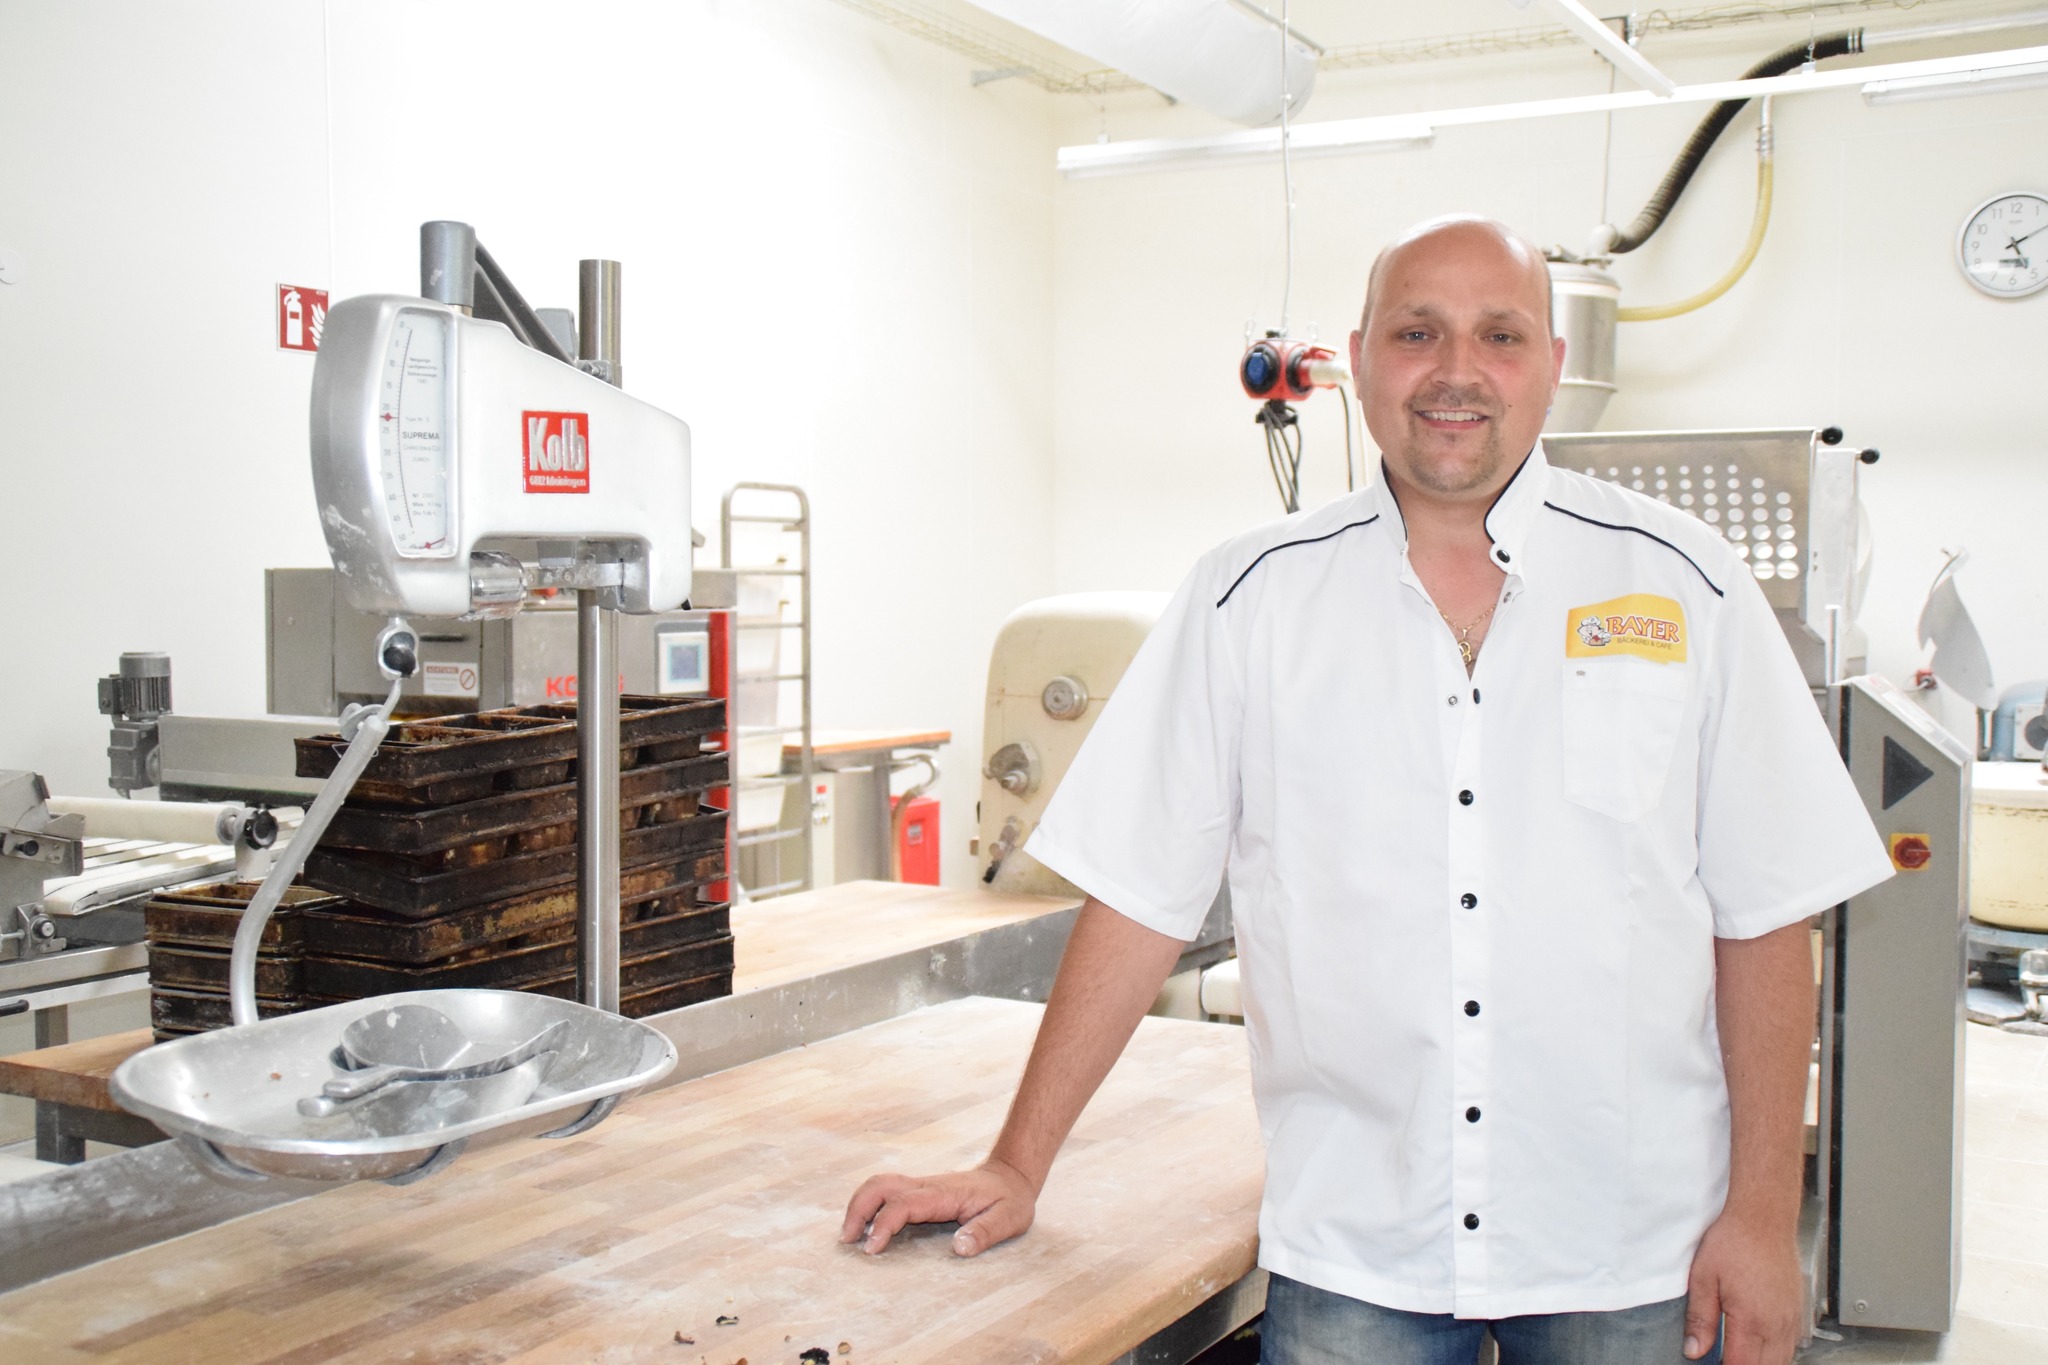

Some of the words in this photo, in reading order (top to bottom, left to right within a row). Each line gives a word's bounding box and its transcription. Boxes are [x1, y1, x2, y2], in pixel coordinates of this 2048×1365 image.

[1992, 208, 2003, 219] 11
[2010, 202, 2023, 214] 12
[2035, 205, 2039, 216] 1
[1977, 223, 1988, 235] 10
[1971, 240, 1980, 252] 9
[2030, 267, 2038, 280] 5
[2008, 274, 2017, 286] 6
[382, 403, 390, 411] 20
[382, 426, 390, 434] 25
[402, 431, 440, 440] SUPREMA
[528, 417, 586, 471] Kolb
[388, 493, 397, 501] 40
[393, 513, 401, 522] 45
[398, 532, 406, 542] 50
[1606, 615, 1680, 643] BAYER
